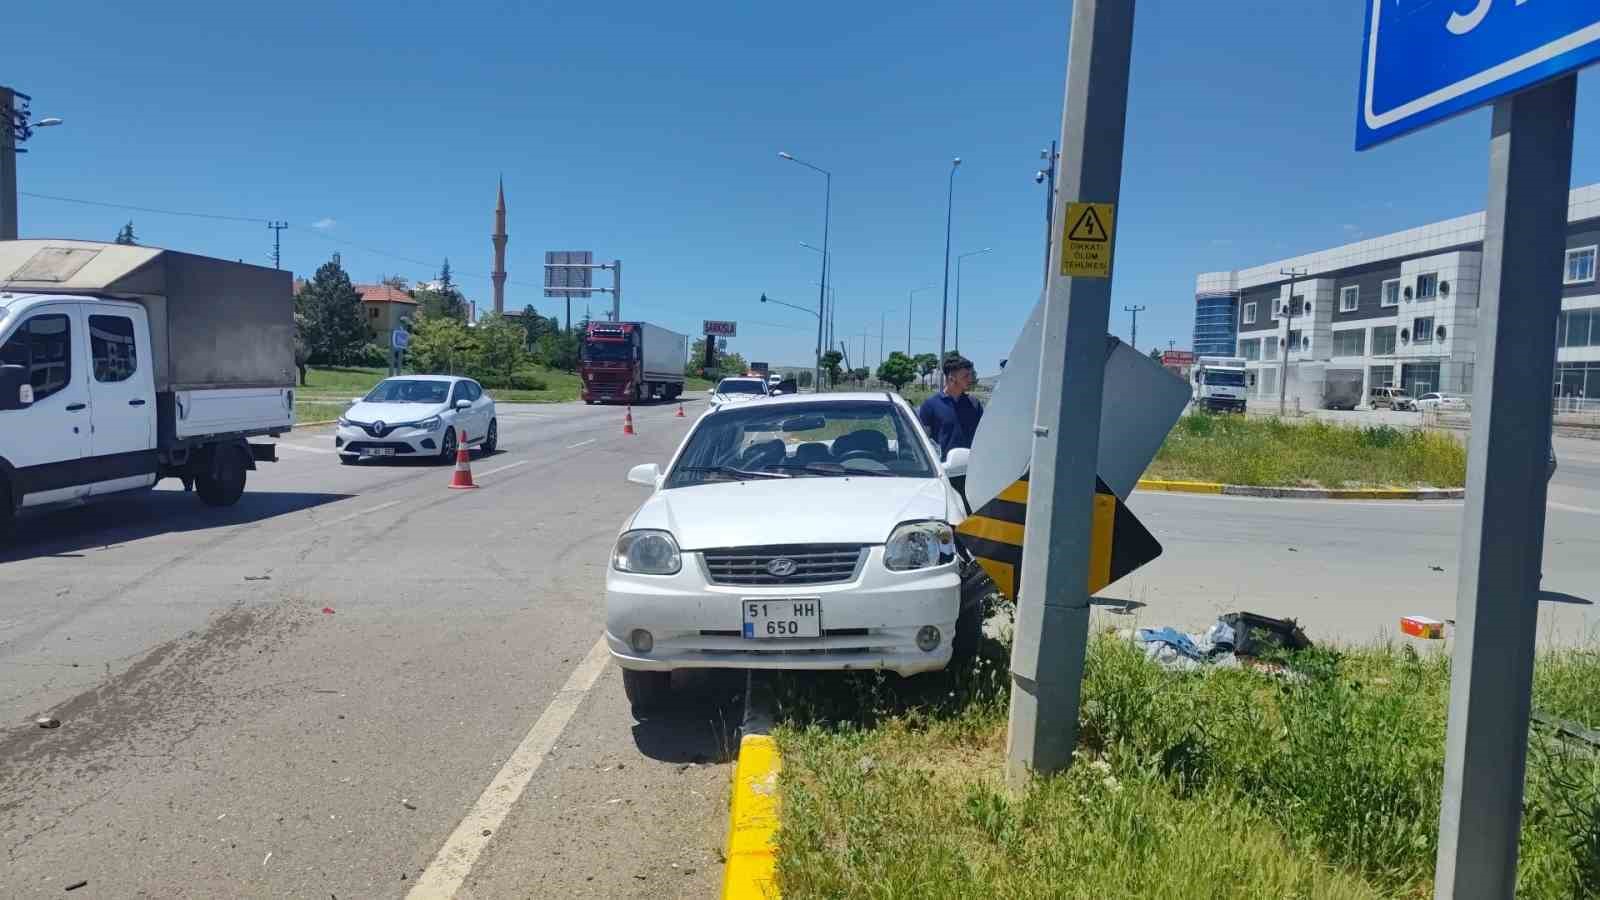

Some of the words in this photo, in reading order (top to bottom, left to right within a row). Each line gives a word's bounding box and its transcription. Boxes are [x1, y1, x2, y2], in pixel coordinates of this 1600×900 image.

[749, 604, 768, 617] 51
[793, 603, 815, 617] HH
[766, 620, 799, 634] 650
